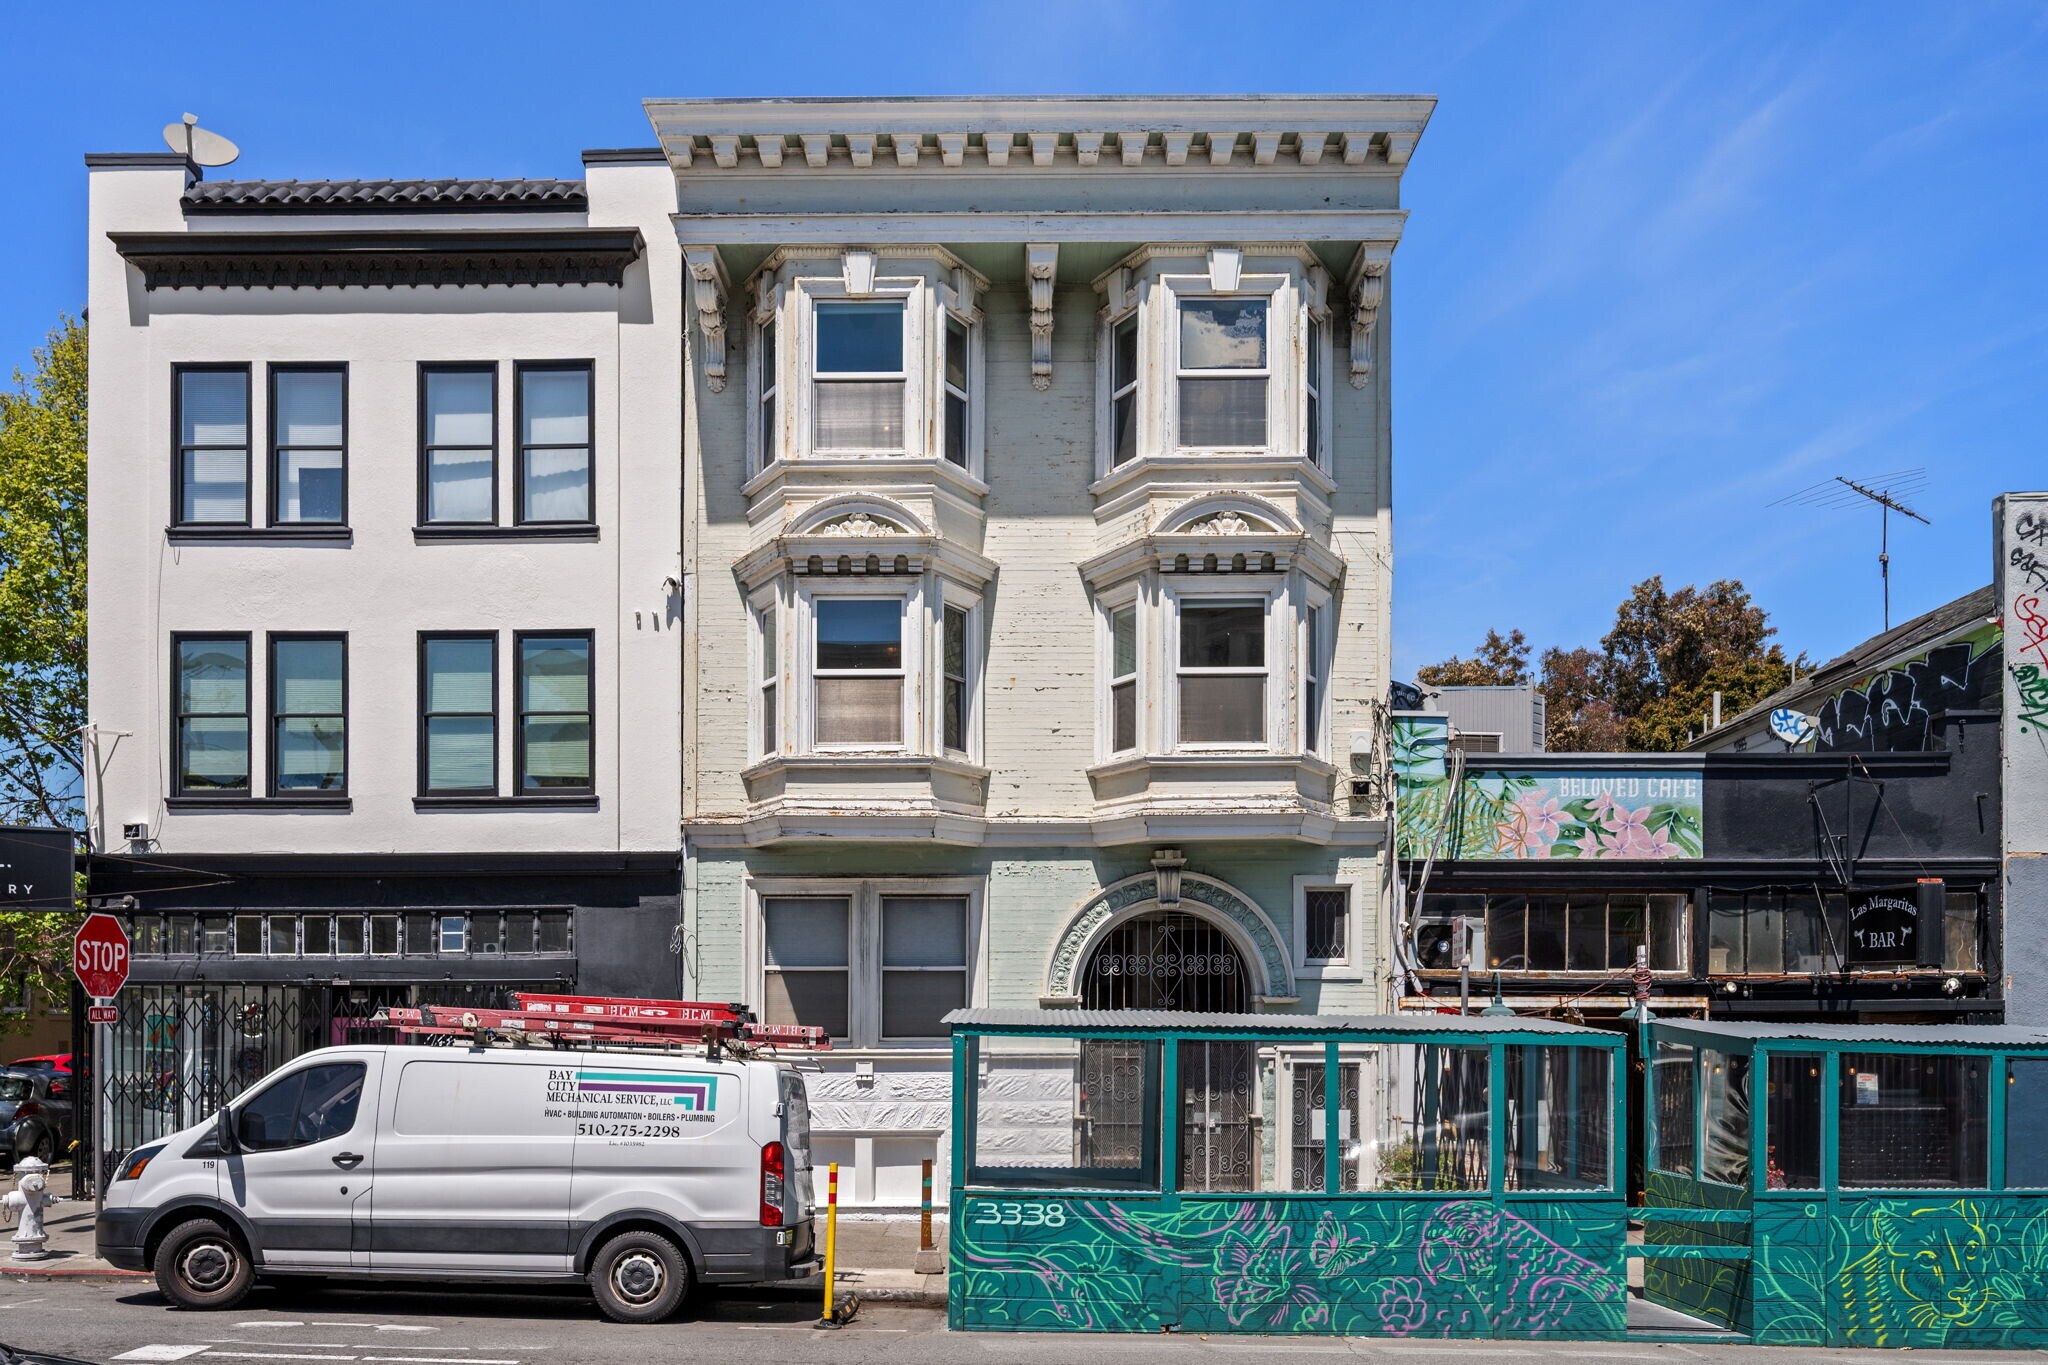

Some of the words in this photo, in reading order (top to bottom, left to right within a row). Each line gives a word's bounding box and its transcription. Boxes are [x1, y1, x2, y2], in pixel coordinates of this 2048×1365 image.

[1560, 778, 1639, 799] BELOVED
[1647, 778, 1697, 798] CAFE
[1850, 904, 1867, 920] Las
[1868, 895, 1918, 916] Margaritas
[1869, 931, 1896, 948] BAR
[78, 939, 126, 972] STOP
[91, 1009, 102, 1020] ALL
[103, 1009, 116, 1020] WAY
[548, 1070, 573, 1080] BAY
[547, 1081, 576, 1091] CITY
[546, 1092, 614, 1104] MECHANICAL
[614, 1094, 659, 1106] SERVICE,
[659, 1098, 673, 1106] LLC
[544, 1108, 562, 1118] HVAC
[567, 1110, 599, 1119] BUILDING
[600, 1111, 643, 1121] AUTOMATION
[647, 1112, 676, 1122] BOILERS
[680, 1114, 716, 1123] PLUMBING
[577, 1123, 681, 1138] 510-275-2298
[202, 1160, 215, 1169] 119
[975, 1203, 1066, 1227] 3338
